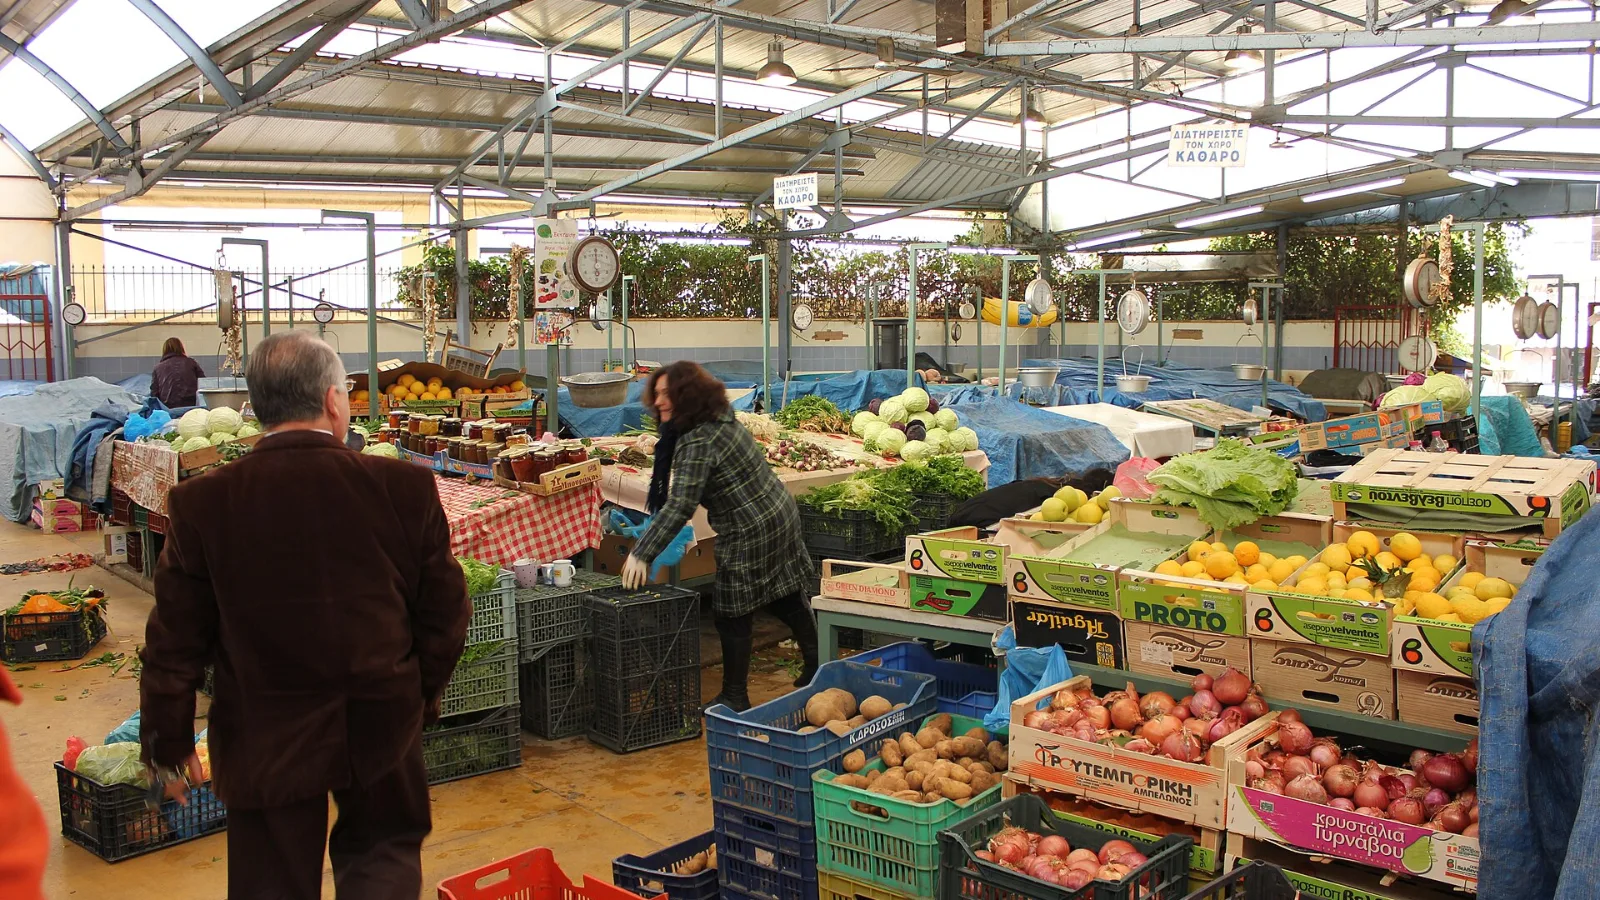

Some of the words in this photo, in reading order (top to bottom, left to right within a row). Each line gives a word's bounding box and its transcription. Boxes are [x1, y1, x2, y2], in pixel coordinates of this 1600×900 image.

[1174, 130, 1244, 139] ΔΙΑΤΗΡΕΙΣΤΕ
[1176, 150, 1240, 162] ΚΑΘΑΡΟ
[776, 177, 814, 188] ΔΙΑΤΗΡΕΙΣΤΕ
[778, 193, 814, 205] ΚΑΘΑΡΟ
[963, 561, 997, 571] velventos
[836, 582, 858, 592] GREEN
[859, 586, 896, 596] DIAMOND
[1050, 584, 1072, 593] asepop
[1072, 586, 1109, 598] velventos
[1134, 601, 1226, 632] PROTO
[1026, 612, 1108, 638] Aguilar
[1303, 622, 1330, 632] asepop
[1330, 625, 1380, 638] velventos
[1034, 744, 1192, 798] ΦΡΟΥΤΕΜΠΟΡΙΚΗ
[1133, 787, 1192, 806] ΑΜΠΕΛΩΝΟΣ
[1316, 812, 1404, 843] κρυστάλια
[1312, 822, 1404, 858] Τυρνάβου
